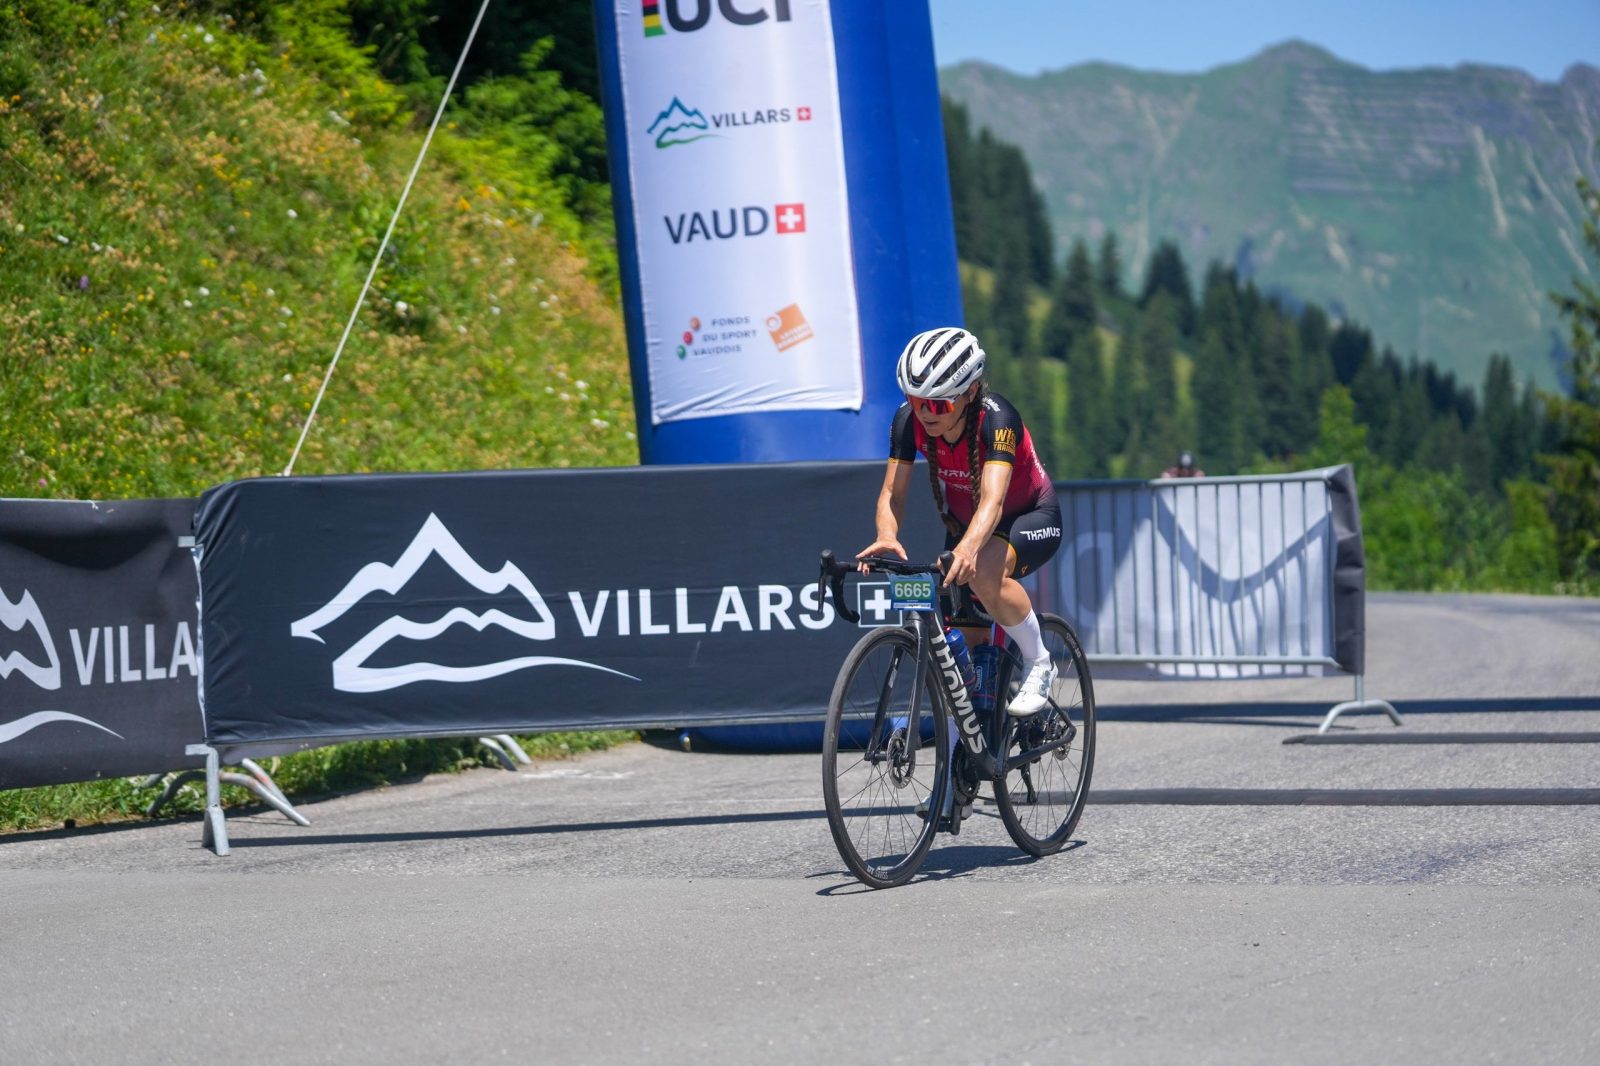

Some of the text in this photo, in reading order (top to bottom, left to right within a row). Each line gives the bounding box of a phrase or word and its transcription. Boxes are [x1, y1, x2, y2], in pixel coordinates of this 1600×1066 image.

[712, 108, 791, 128] VILLARS
[664, 205, 769, 245] VAUD
[711, 315, 751, 327] FONDS
[894, 582, 932, 598] 6665
[568, 582, 836, 637] VILLARS
